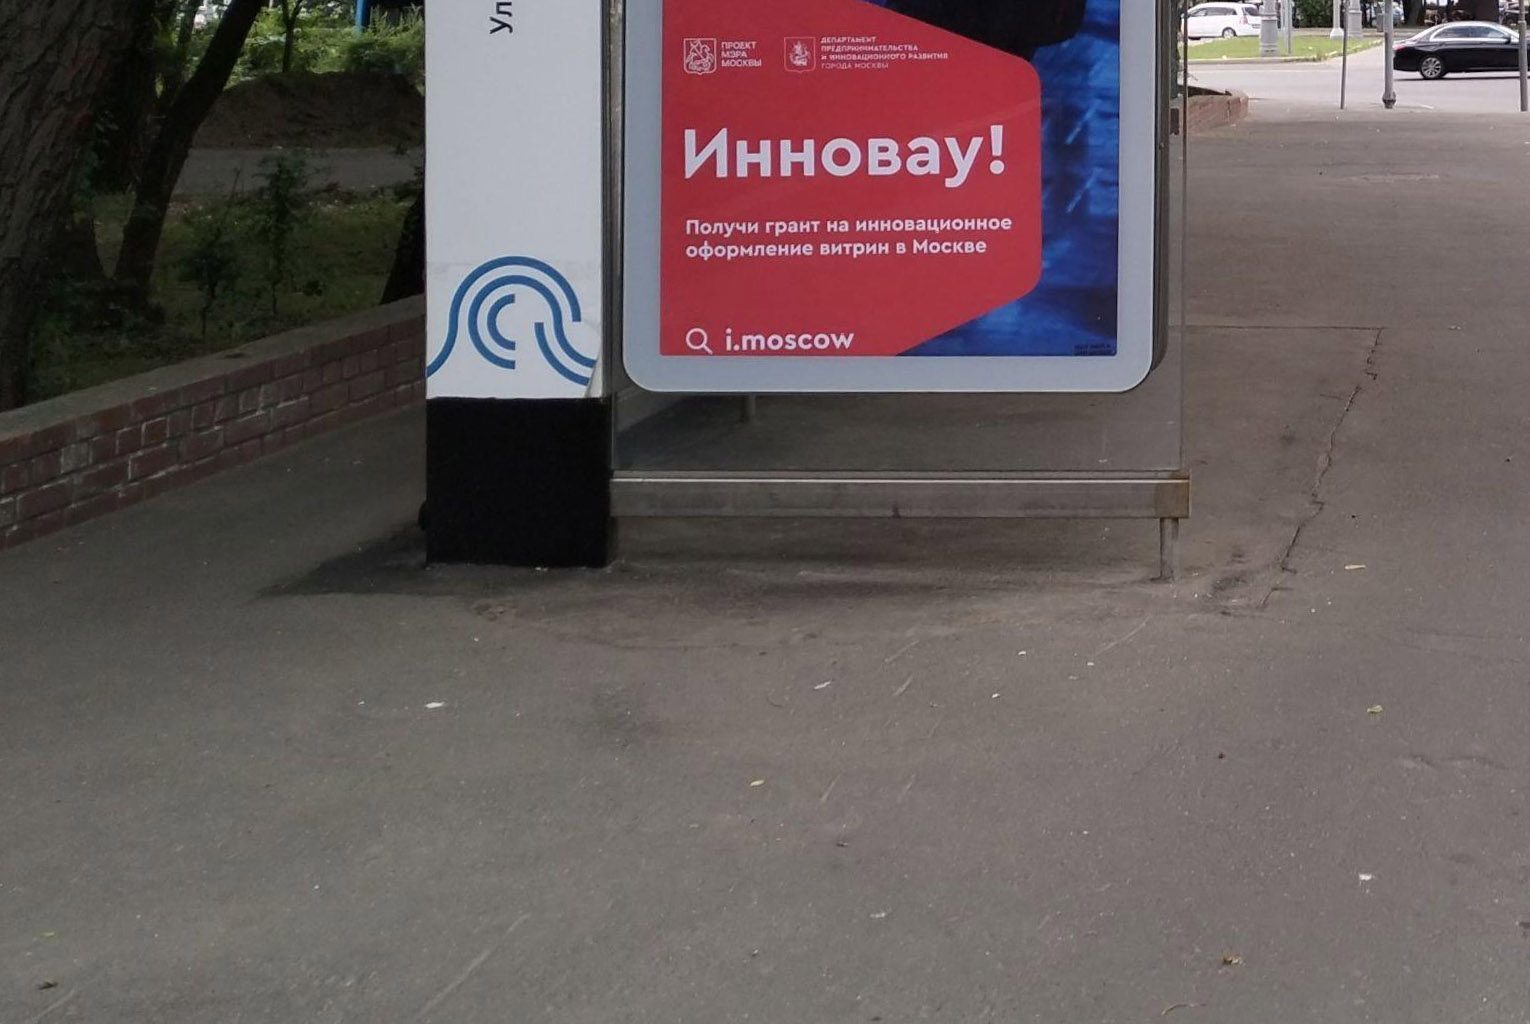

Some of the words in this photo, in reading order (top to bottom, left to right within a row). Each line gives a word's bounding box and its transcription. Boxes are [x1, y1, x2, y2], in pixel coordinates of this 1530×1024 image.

[820, 36, 877, 45] ДЕПАРТАМЕНТ
[721, 41, 757, 50] ПРОЕКТ
[721, 51, 748, 59] МЭРА
[721, 59, 762, 68] МОСКВЫ
[821, 62, 852, 70] ГОРОДА
[854, 61, 889, 69] МОСКВЫ
[683, 124, 1006, 189] Инновау!
[685, 218, 760, 237] Получи
[764, 219, 820, 236] грант
[826, 219, 849, 233] на
[855, 215, 1013, 235] инновационное
[685, 241, 813, 262] оформление
[819, 241, 890, 257] витрин
[895, 242, 907, 255] в
[912, 237, 987, 255] Москве
[725, 328, 855, 352] i.moscow
